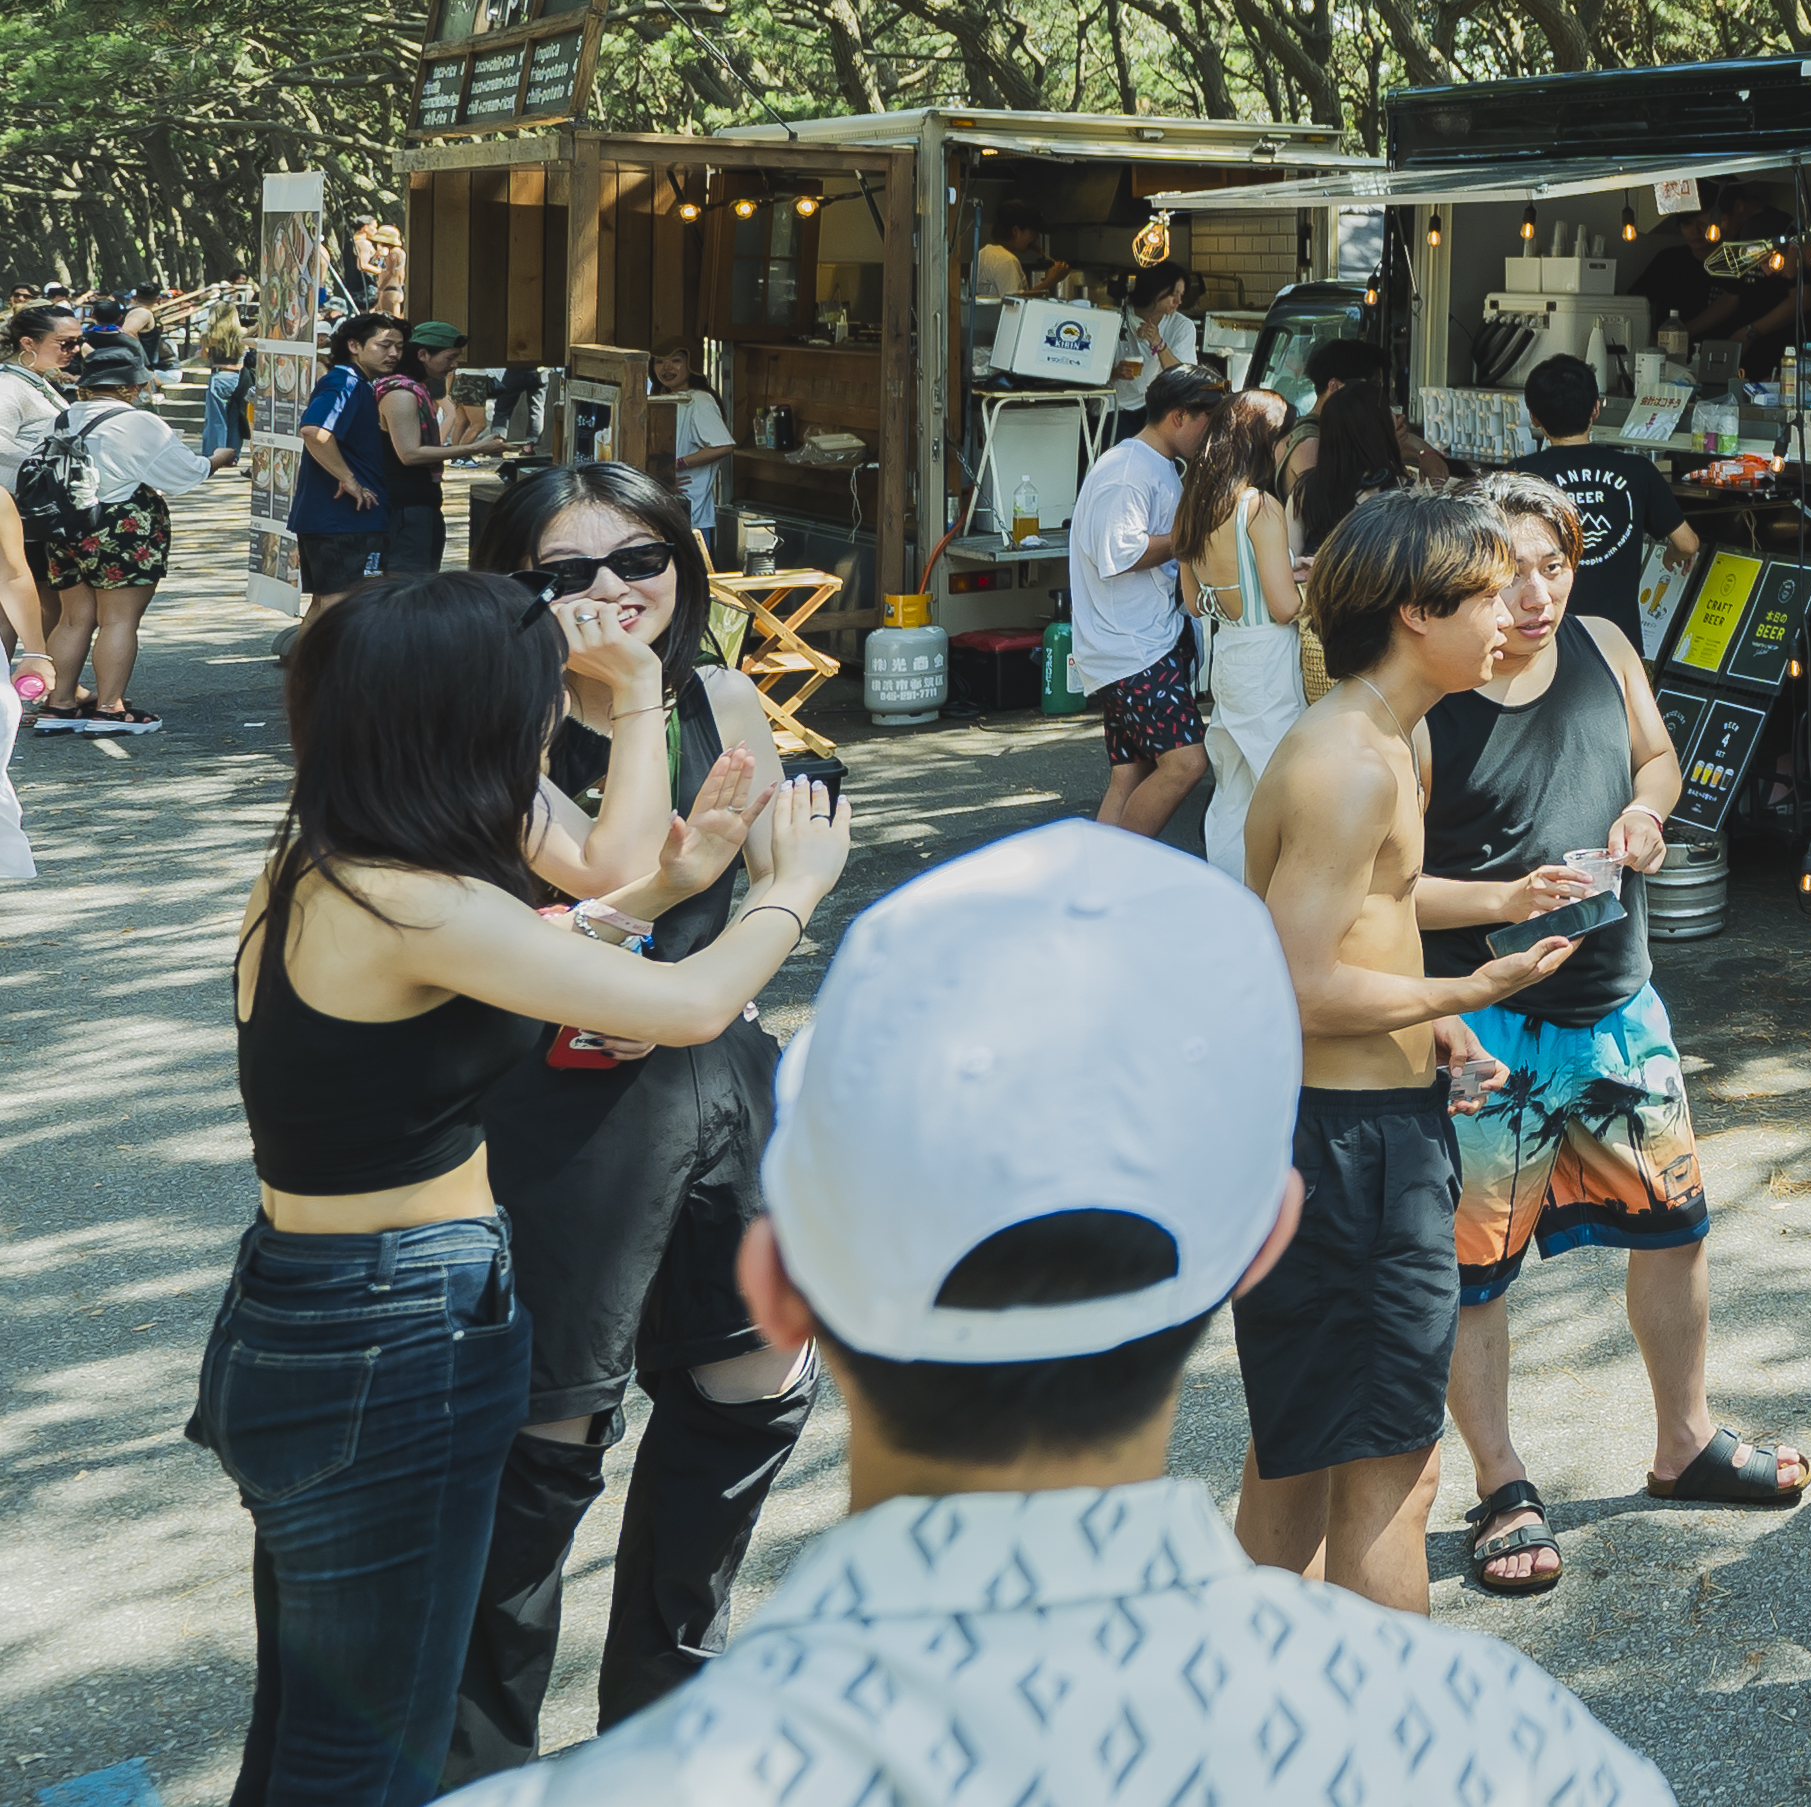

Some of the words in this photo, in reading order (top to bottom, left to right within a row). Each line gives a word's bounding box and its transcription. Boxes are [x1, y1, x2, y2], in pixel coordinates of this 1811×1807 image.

[1055, 338, 1080, 350] KIRIN
[1556, 468, 1628, 491] ANRIKU
[1578, 557, 1603, 566] eople
[1706, 598, 1733, 614] CRAFT
[1703, 613, 1725, 627] BEER
[1755, 623, 1786, 641] BEER
[1721, 732, 1731, 748] 4
